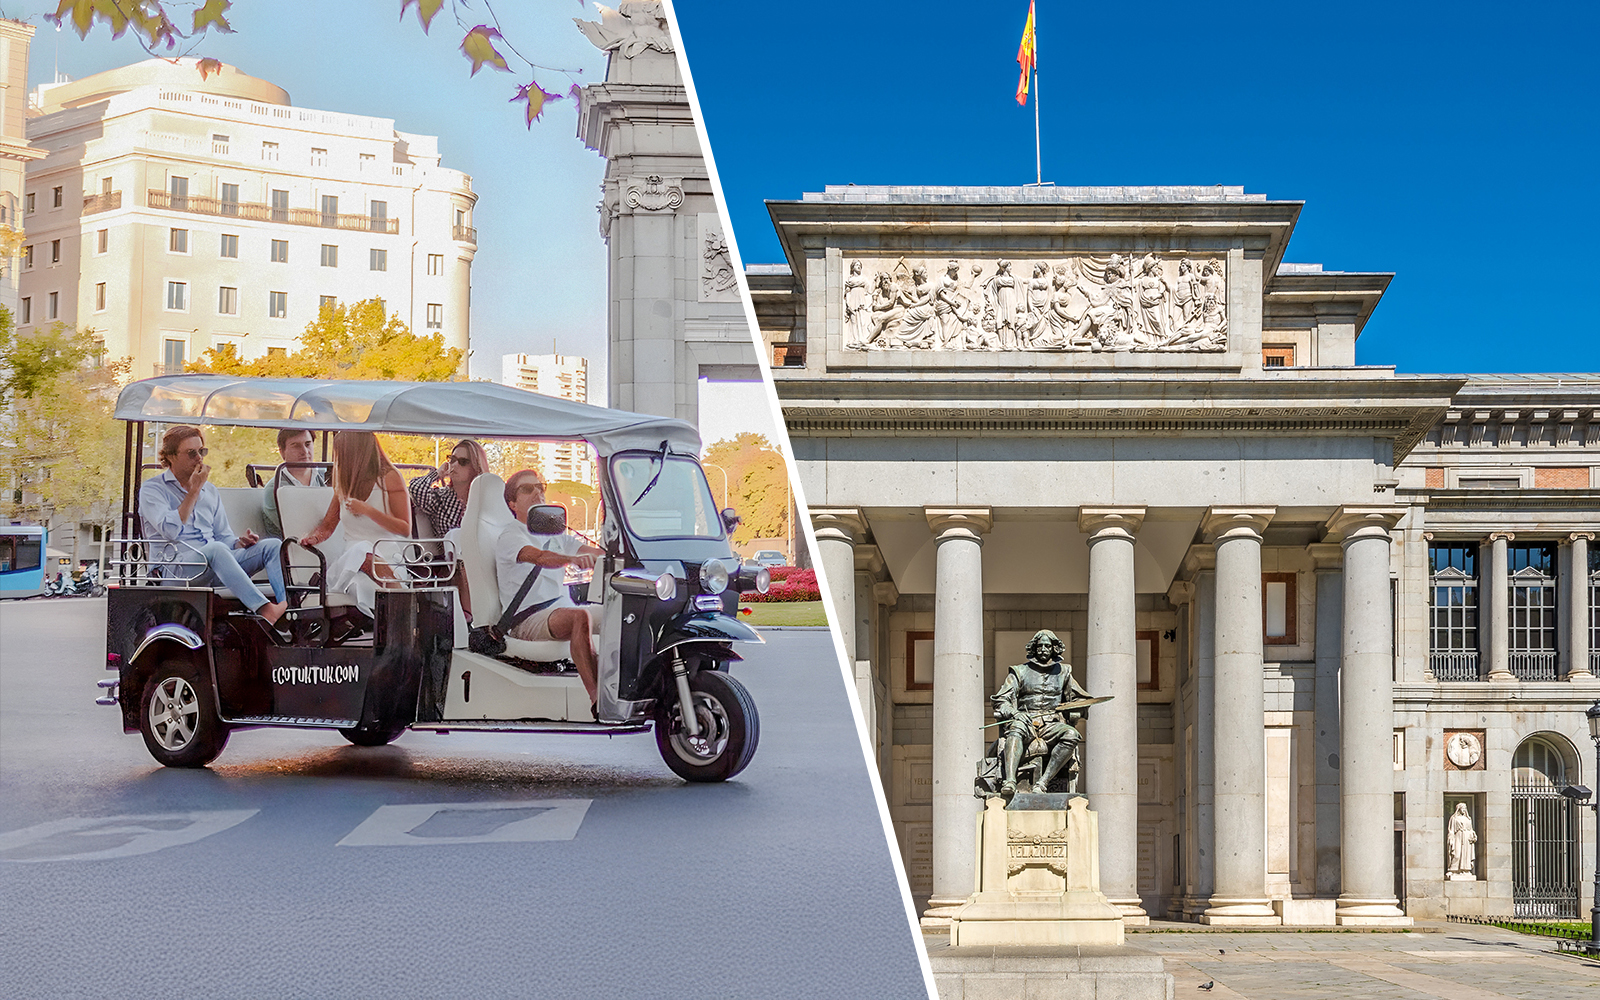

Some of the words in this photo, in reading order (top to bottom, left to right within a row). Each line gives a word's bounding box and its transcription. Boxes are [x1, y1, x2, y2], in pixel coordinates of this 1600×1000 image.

[272, 665, 359, 685] ECOTUKTUK.COM
[461, 670, 471, 703] 1
[1009, 846, 1065, 858] VELAZQUEZ
